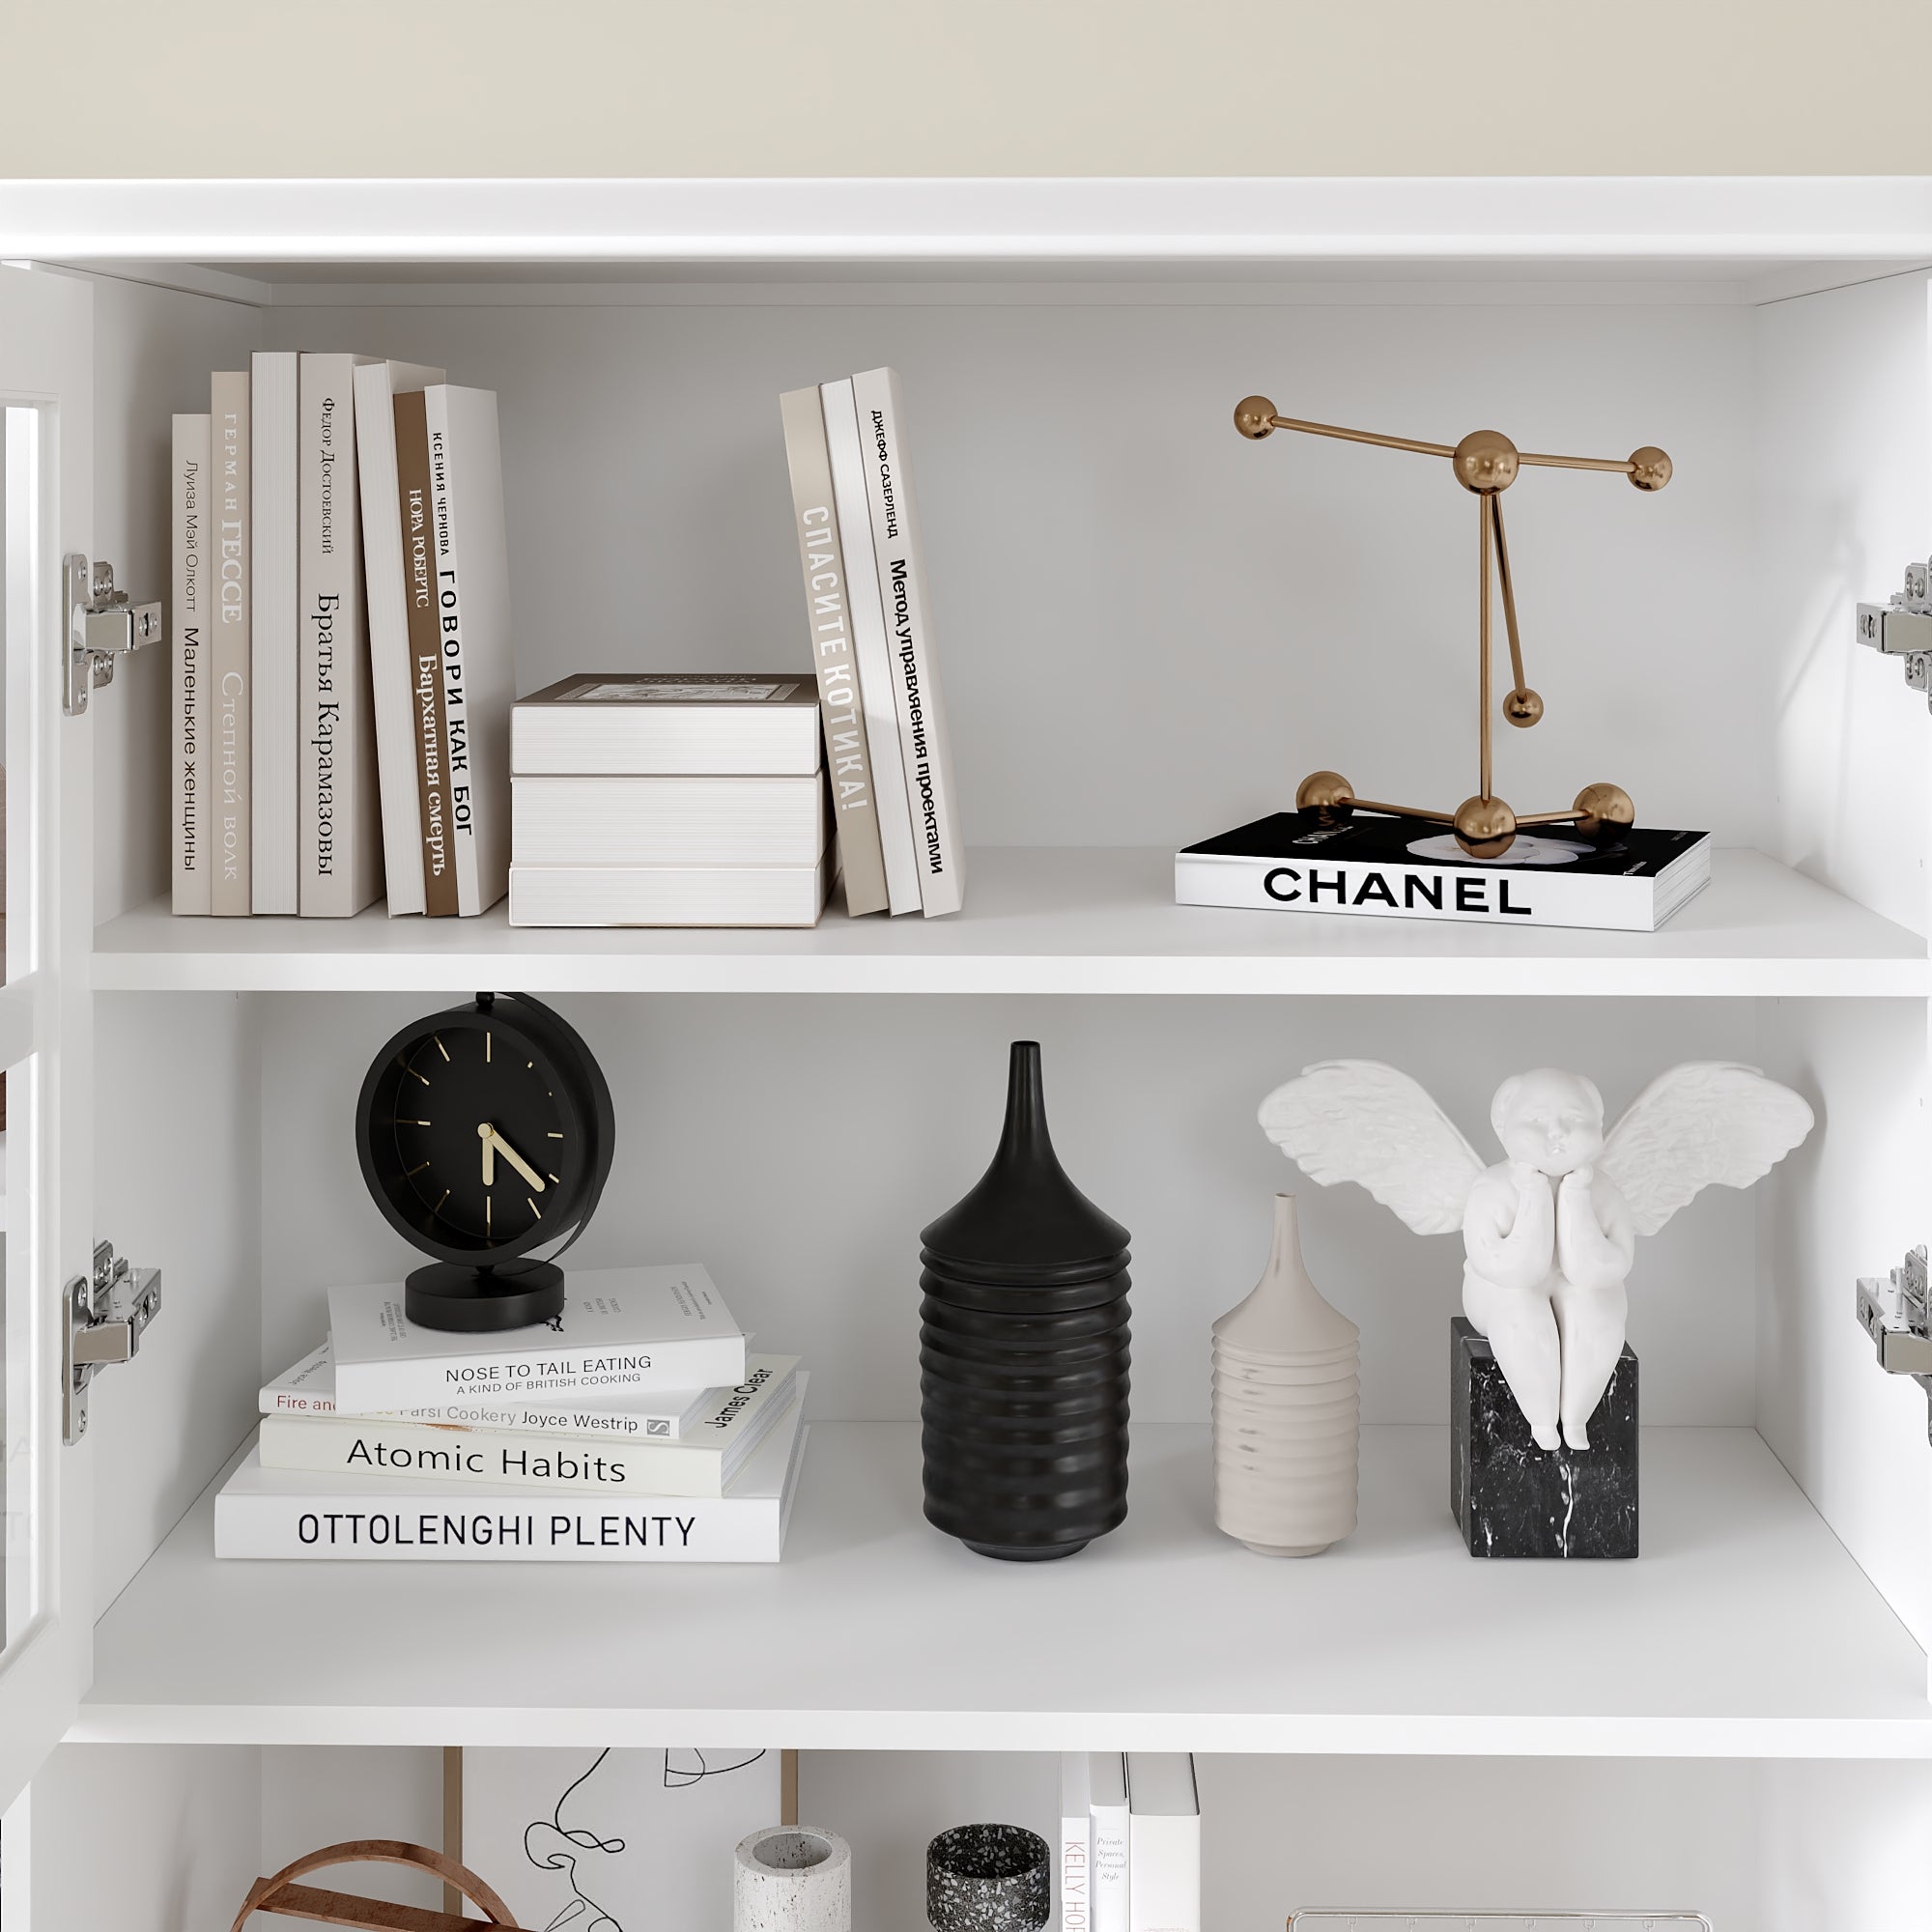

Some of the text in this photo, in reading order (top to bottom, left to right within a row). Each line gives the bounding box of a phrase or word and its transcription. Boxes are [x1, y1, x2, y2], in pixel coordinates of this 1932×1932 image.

[184, 461, 198, 611] Луиза Мэй Олкотт
[222, 414, 242, 623] ГЕРМАН ГЕССЕ
[433, 433, 449, 556] КСЕНИЯ ЧЕРНОВА
[871, 411, 897, 538] ДЖЕФФ САЗЕРЛЕНД
[410, 490, 428, 608] НОРА РОБЕРТС
[440, 570, 472, 836] ГОВОРИ КАК БОГ
[803, 506, 867, 810] СПАСИТЕ КОТИКА!
[891, 559, 909, 626] Метод
[916, 763, 944, 874] проектами
[183, 629, 198, 869] Маленькие женщины
[222, 672, 242, 880] Степной волк
[311, 594, 339, 875] Братья Карамазовы
[416, 654, 445, 877] Бархатная смерть
[1264, 867, 1532, 915] CHANEL
[277, 1395, 307, 1409] Fire
[446, 1406, 517, 1425] Cookery
[446, 1355, 652, 1382] NOSE TO TAIL EATING
[456, 1373, 641, 1395] A KIND OF BRITISH COOKING
[523, 1411, 638, 1433] Joyce Westrip
[705, 1369, 773, 1428] James Clear
[347, 1439, 625, 1482] Atomic Habits
[299, 1515, 695, 1546] OTTOLENGHI PLENTY
[1065, 1842, 1085, 1894] KELLY
